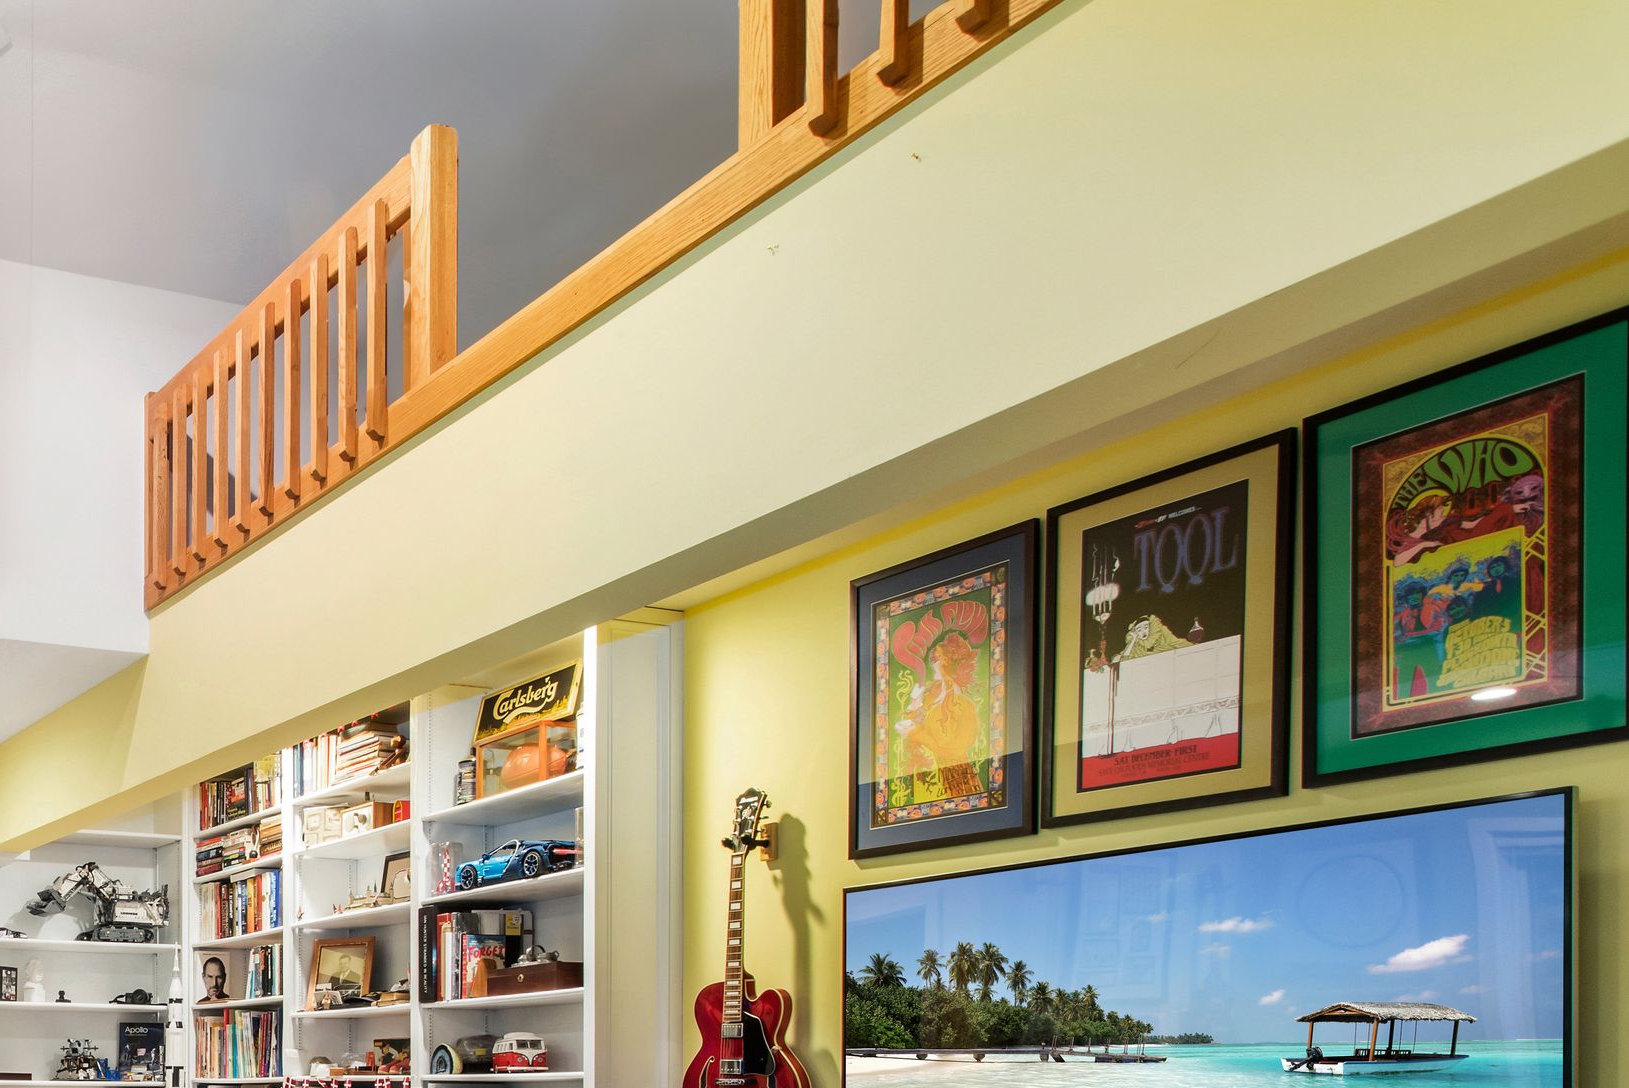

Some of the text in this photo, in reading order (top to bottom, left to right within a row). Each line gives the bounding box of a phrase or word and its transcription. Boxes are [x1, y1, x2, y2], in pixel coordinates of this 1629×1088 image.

[1391, 440, 1535, 510] THE WHO
[1134, 506, 1239, 593] TOOL
[492, 677, 559, 723] Carlsberg
[124, 1026, 149, 1034] Apollo
